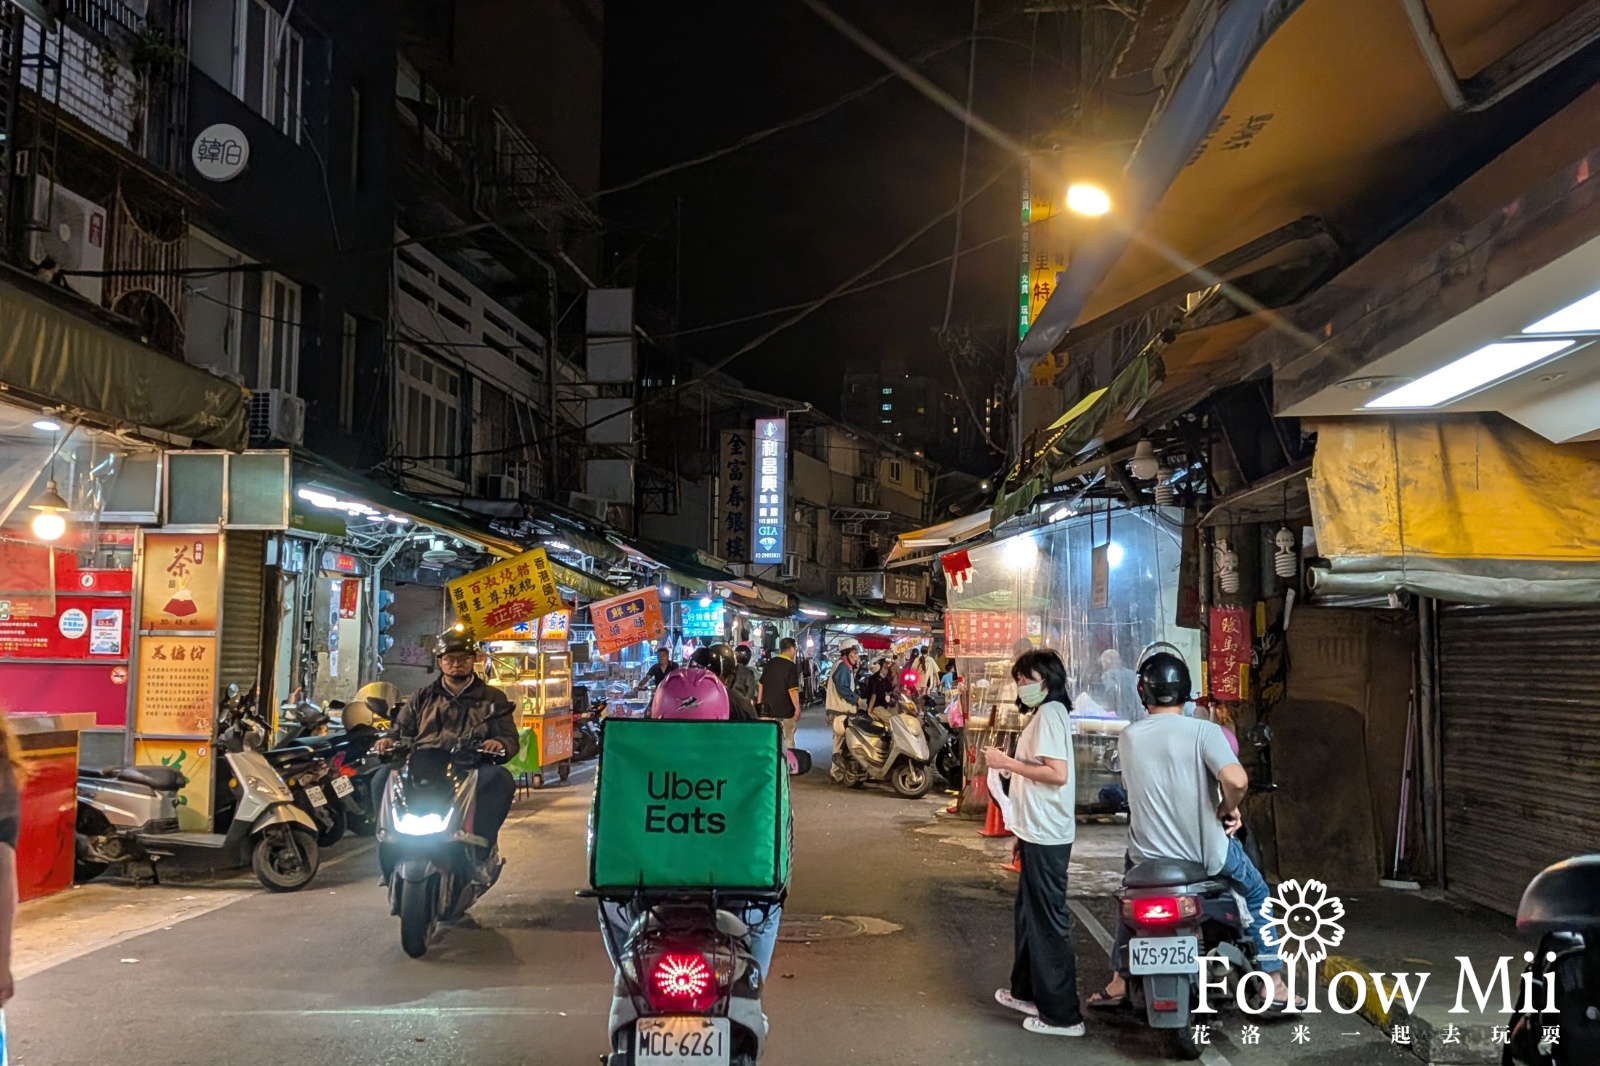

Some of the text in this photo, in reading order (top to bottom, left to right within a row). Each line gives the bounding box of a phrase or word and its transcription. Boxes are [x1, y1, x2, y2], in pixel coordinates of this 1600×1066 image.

[198, 137, 242, 165] 韓伯
[1021, 274, 1029, 294] 文具
[1020, 305, 1028, 325] 玩具
[758, 526, 778, 536] GIA
[167, 545, 193, 577] 茶
[533, 556, 560, 610] 香港師父
[493, 602, 529, 625] 正宗
[610, 602, 640, 618] 鮮味
[647, 771, 728, 801] Uber
[645, 804, 726, 834] Eats
